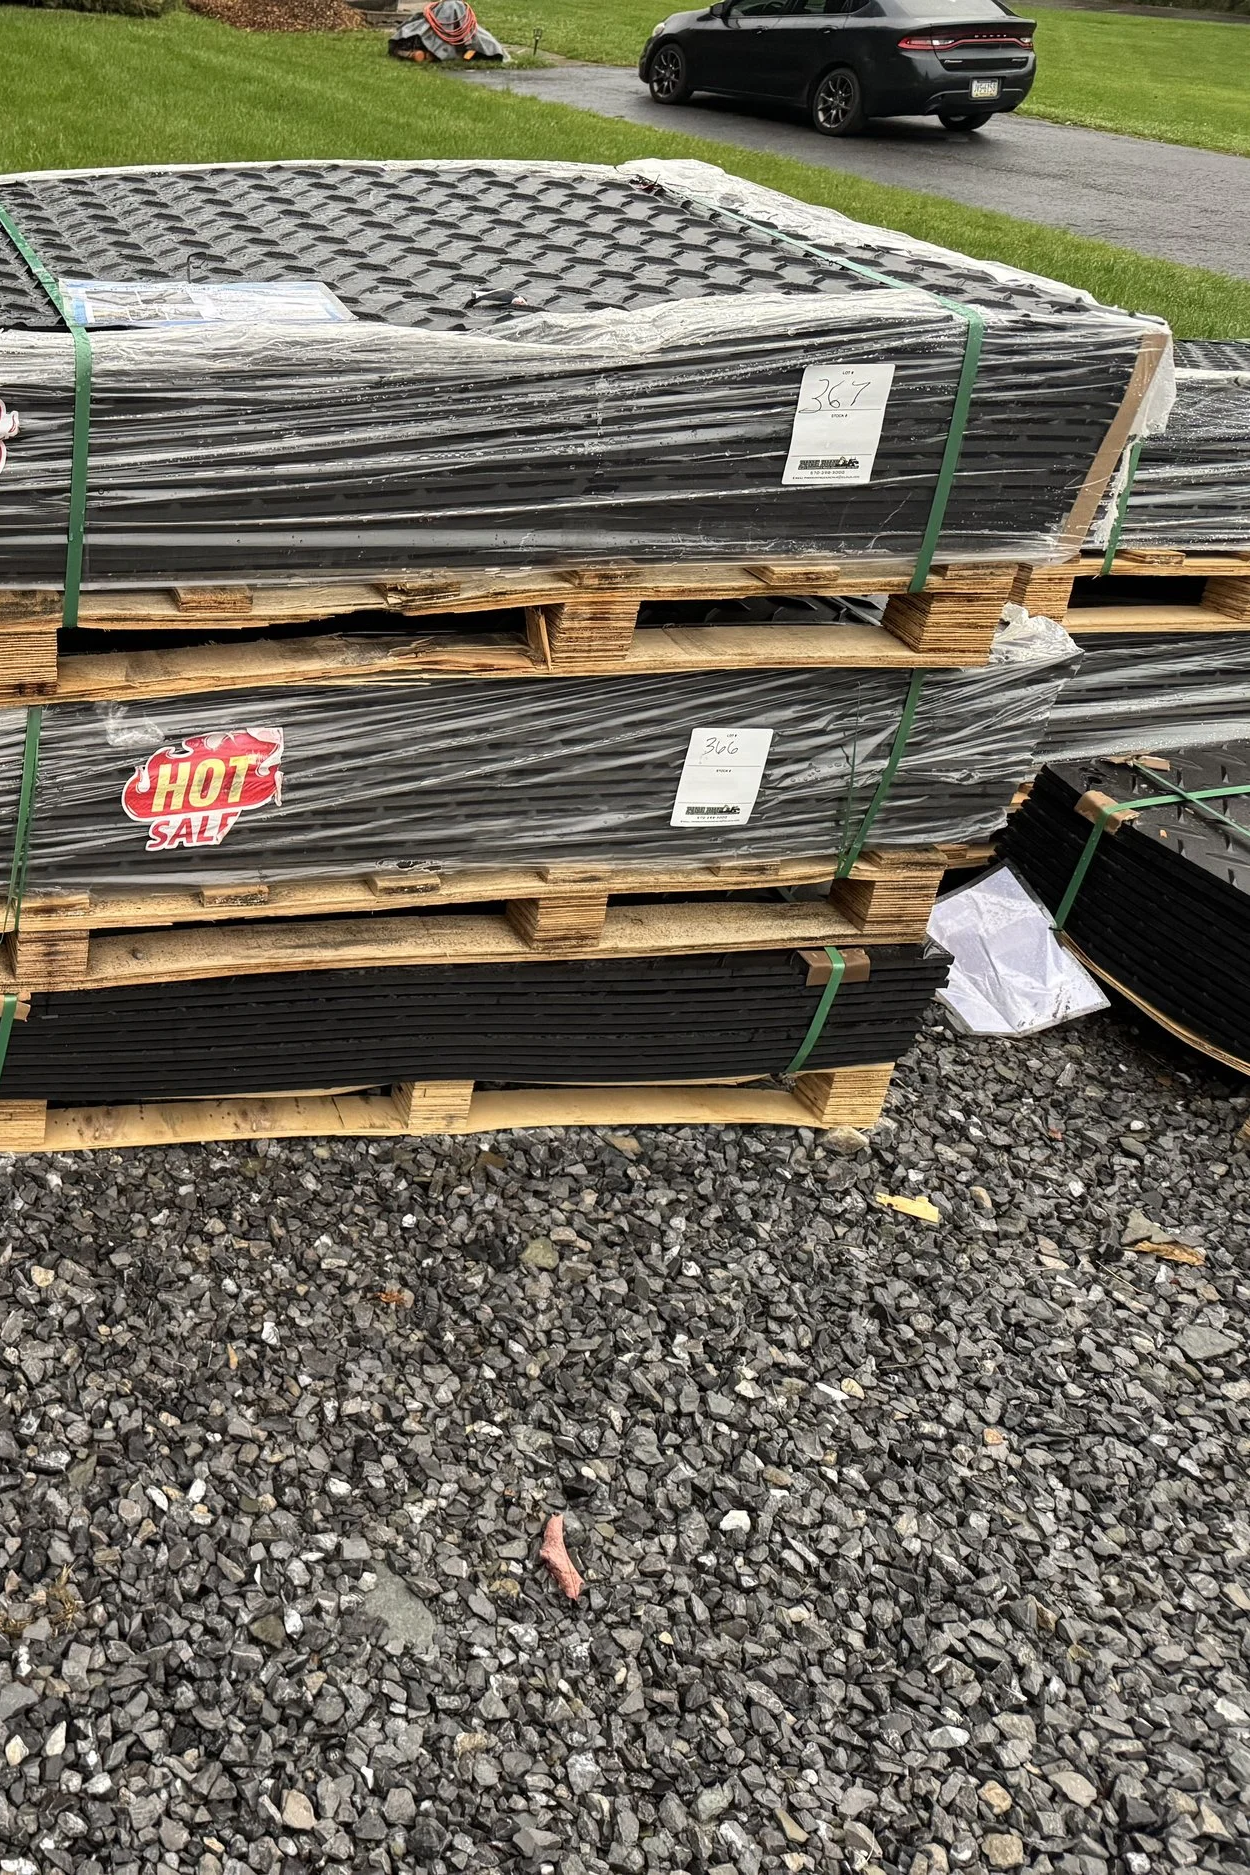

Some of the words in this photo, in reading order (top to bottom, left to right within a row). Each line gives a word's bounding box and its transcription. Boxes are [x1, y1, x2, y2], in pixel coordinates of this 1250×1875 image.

[798, 378, 871, 414] 367
[703, 737, 738, 755] 366
[151, 753, 259, 813] HOT
